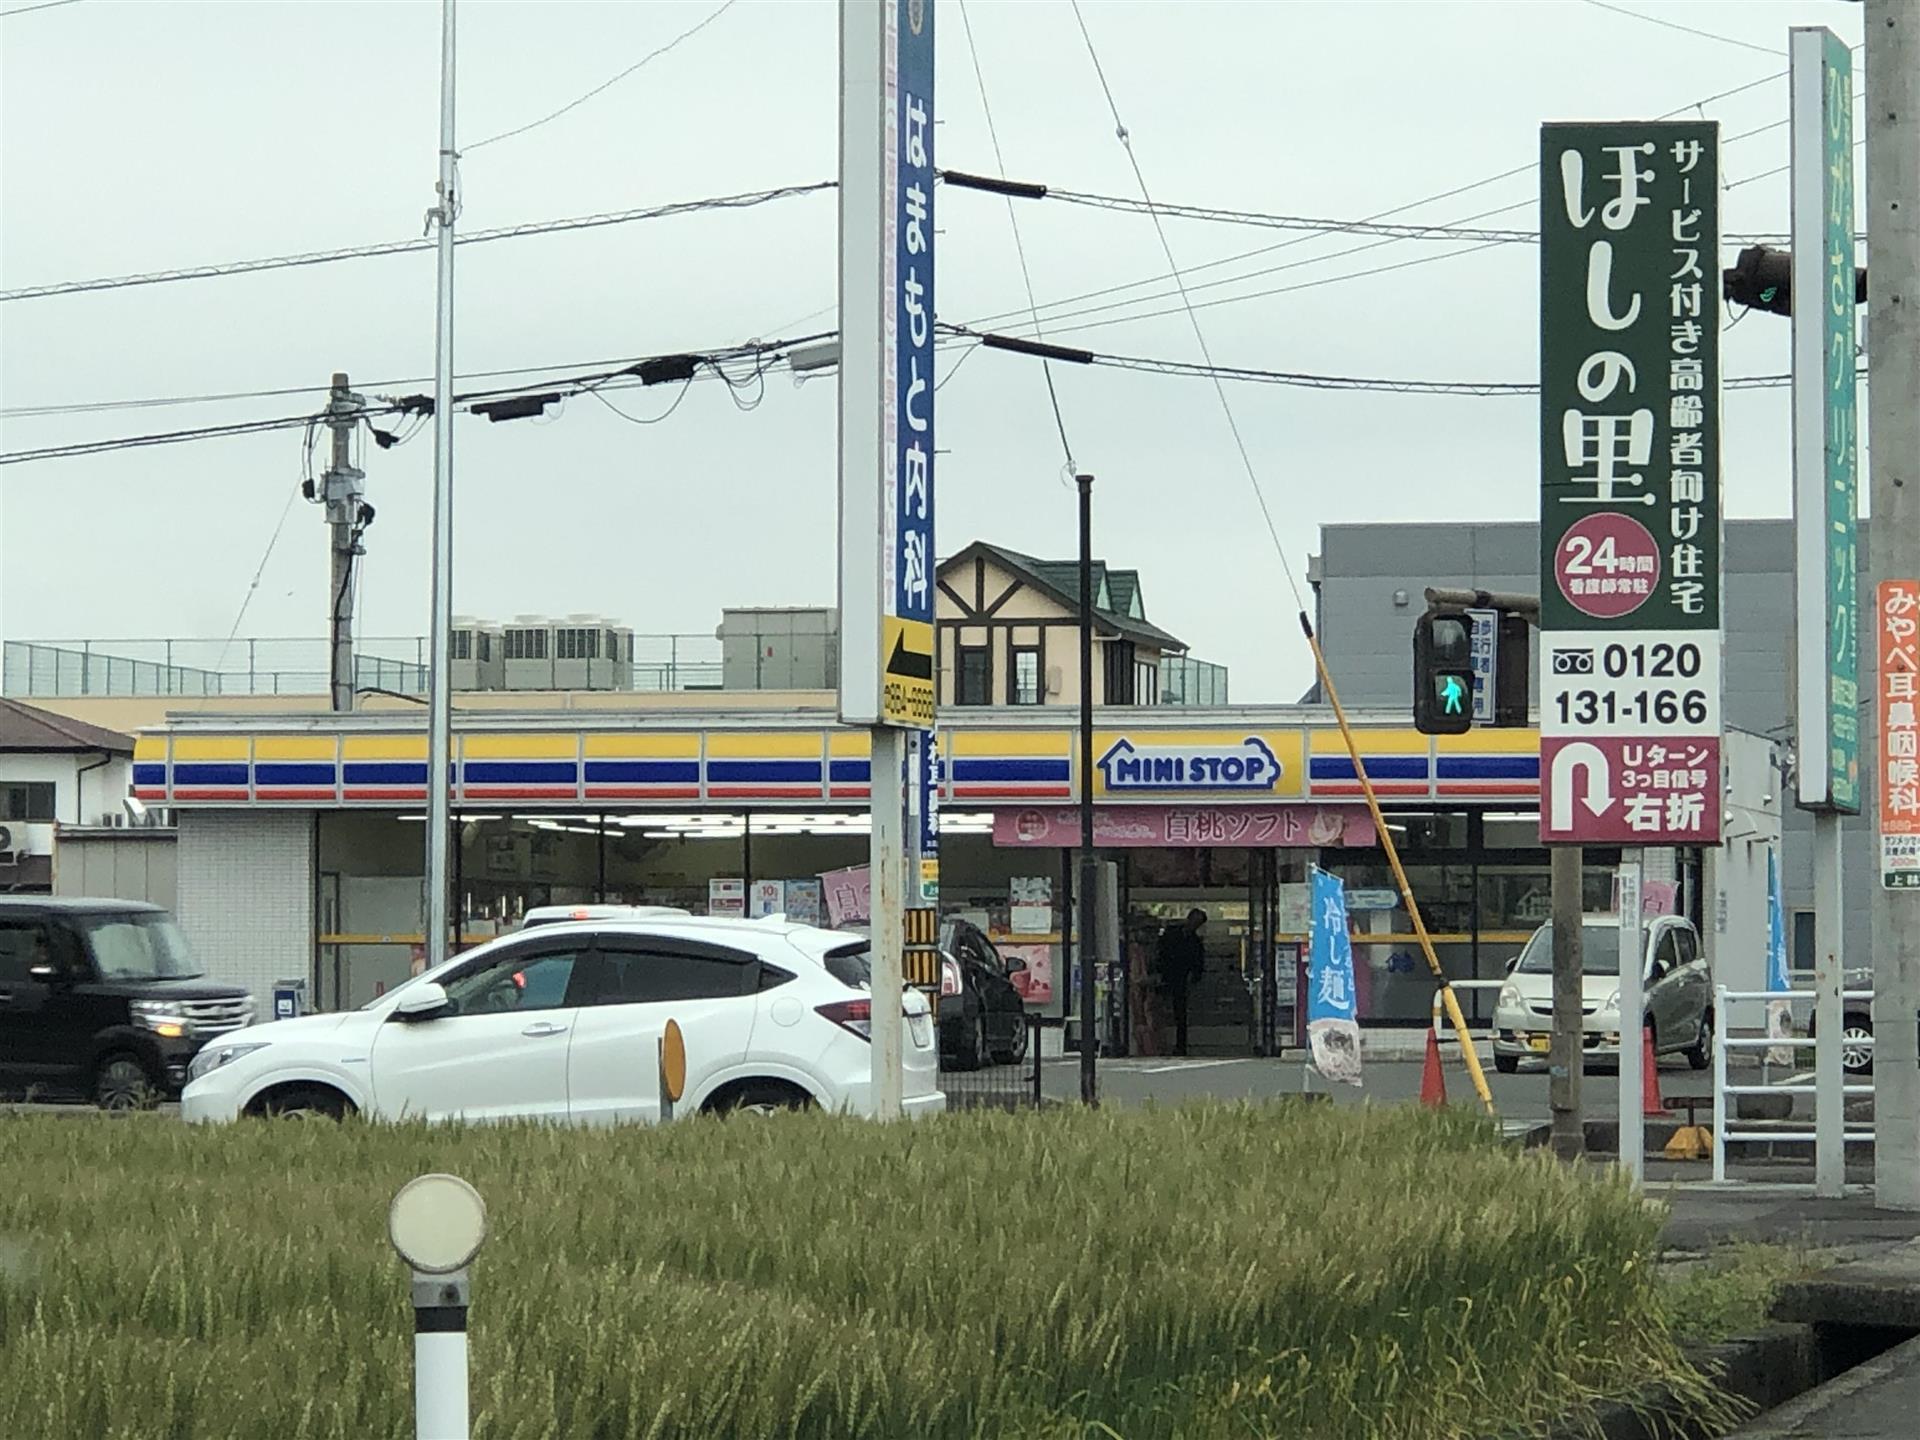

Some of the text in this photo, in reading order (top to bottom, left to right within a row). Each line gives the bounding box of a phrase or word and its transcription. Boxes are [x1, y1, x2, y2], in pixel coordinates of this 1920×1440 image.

[904, 92, 928, 611] はまもと内科
[1669, 139, 1705, 614] サービス付き高齢者向け住宅
[1565, 536, 1654, 575] 24時間
[1603, 643, 1702, 679] 0120
[1555, 689, 1707, 725] 131-166
[1884, 587, 1918, 816] みやべ耳鼻咽喉科
[1117, 757, 1265, 783] MINI STOP
[1622, 744, 1709, 767] Uターン
[1164, 810, 1301, 842] 白桃ソフト
[1623, 791, 1706, 832] 右折
[1317, 896, 1350, 1010] 冷し麺
